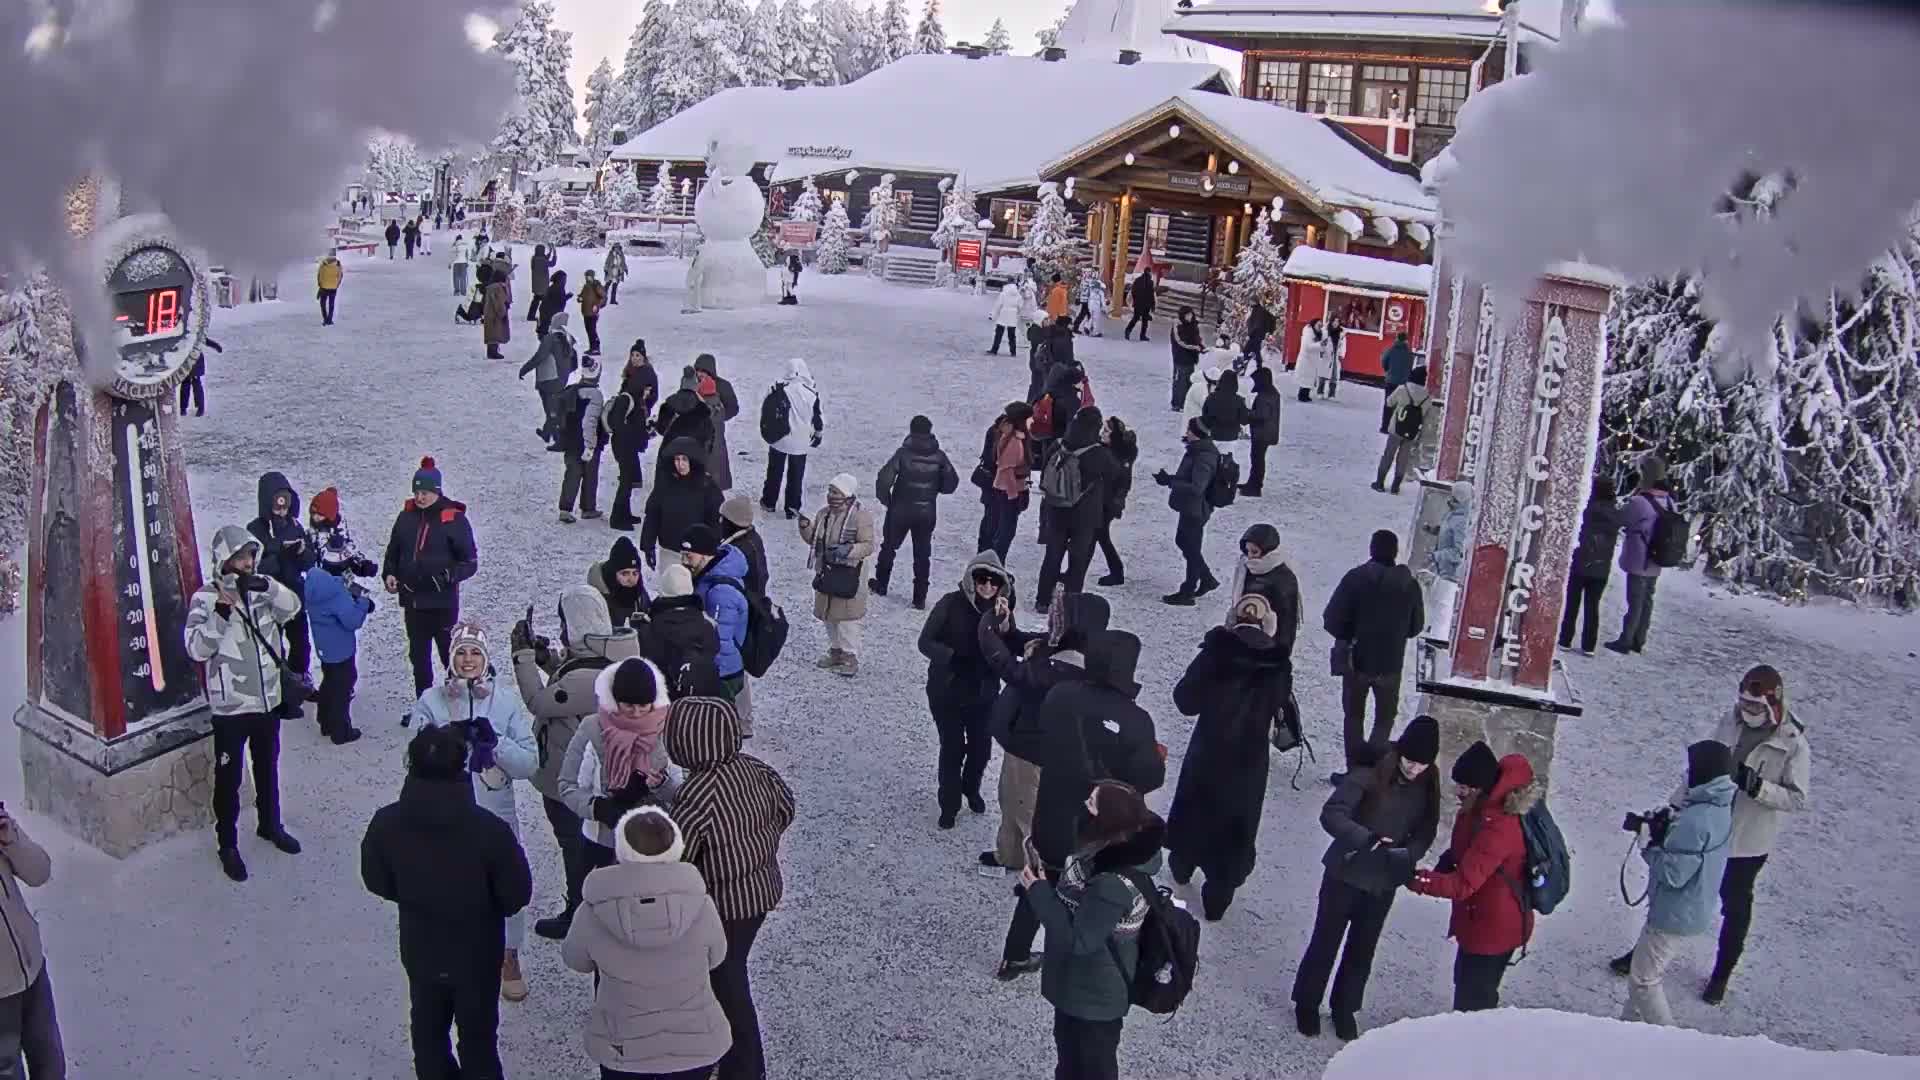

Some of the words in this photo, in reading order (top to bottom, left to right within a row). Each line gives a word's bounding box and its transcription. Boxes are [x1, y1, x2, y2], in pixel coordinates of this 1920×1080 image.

[130, 382, 164, 399] CLAUS
[1527, 316, 1568, 481] ARCTIC
[146, 490, 159, 506] 20
[149, 520, 160, 536] 10
[129, 554, 137, 569] 0
[152, 549, 159, 563] 0
[124, 582, 140, 597] -10
[1501, 504, 1544, 667] CIRCLE
[127, 609, 143, 624] -20
[129, 635, 146, 651] -30
[132, 662, 151, 677] -40
